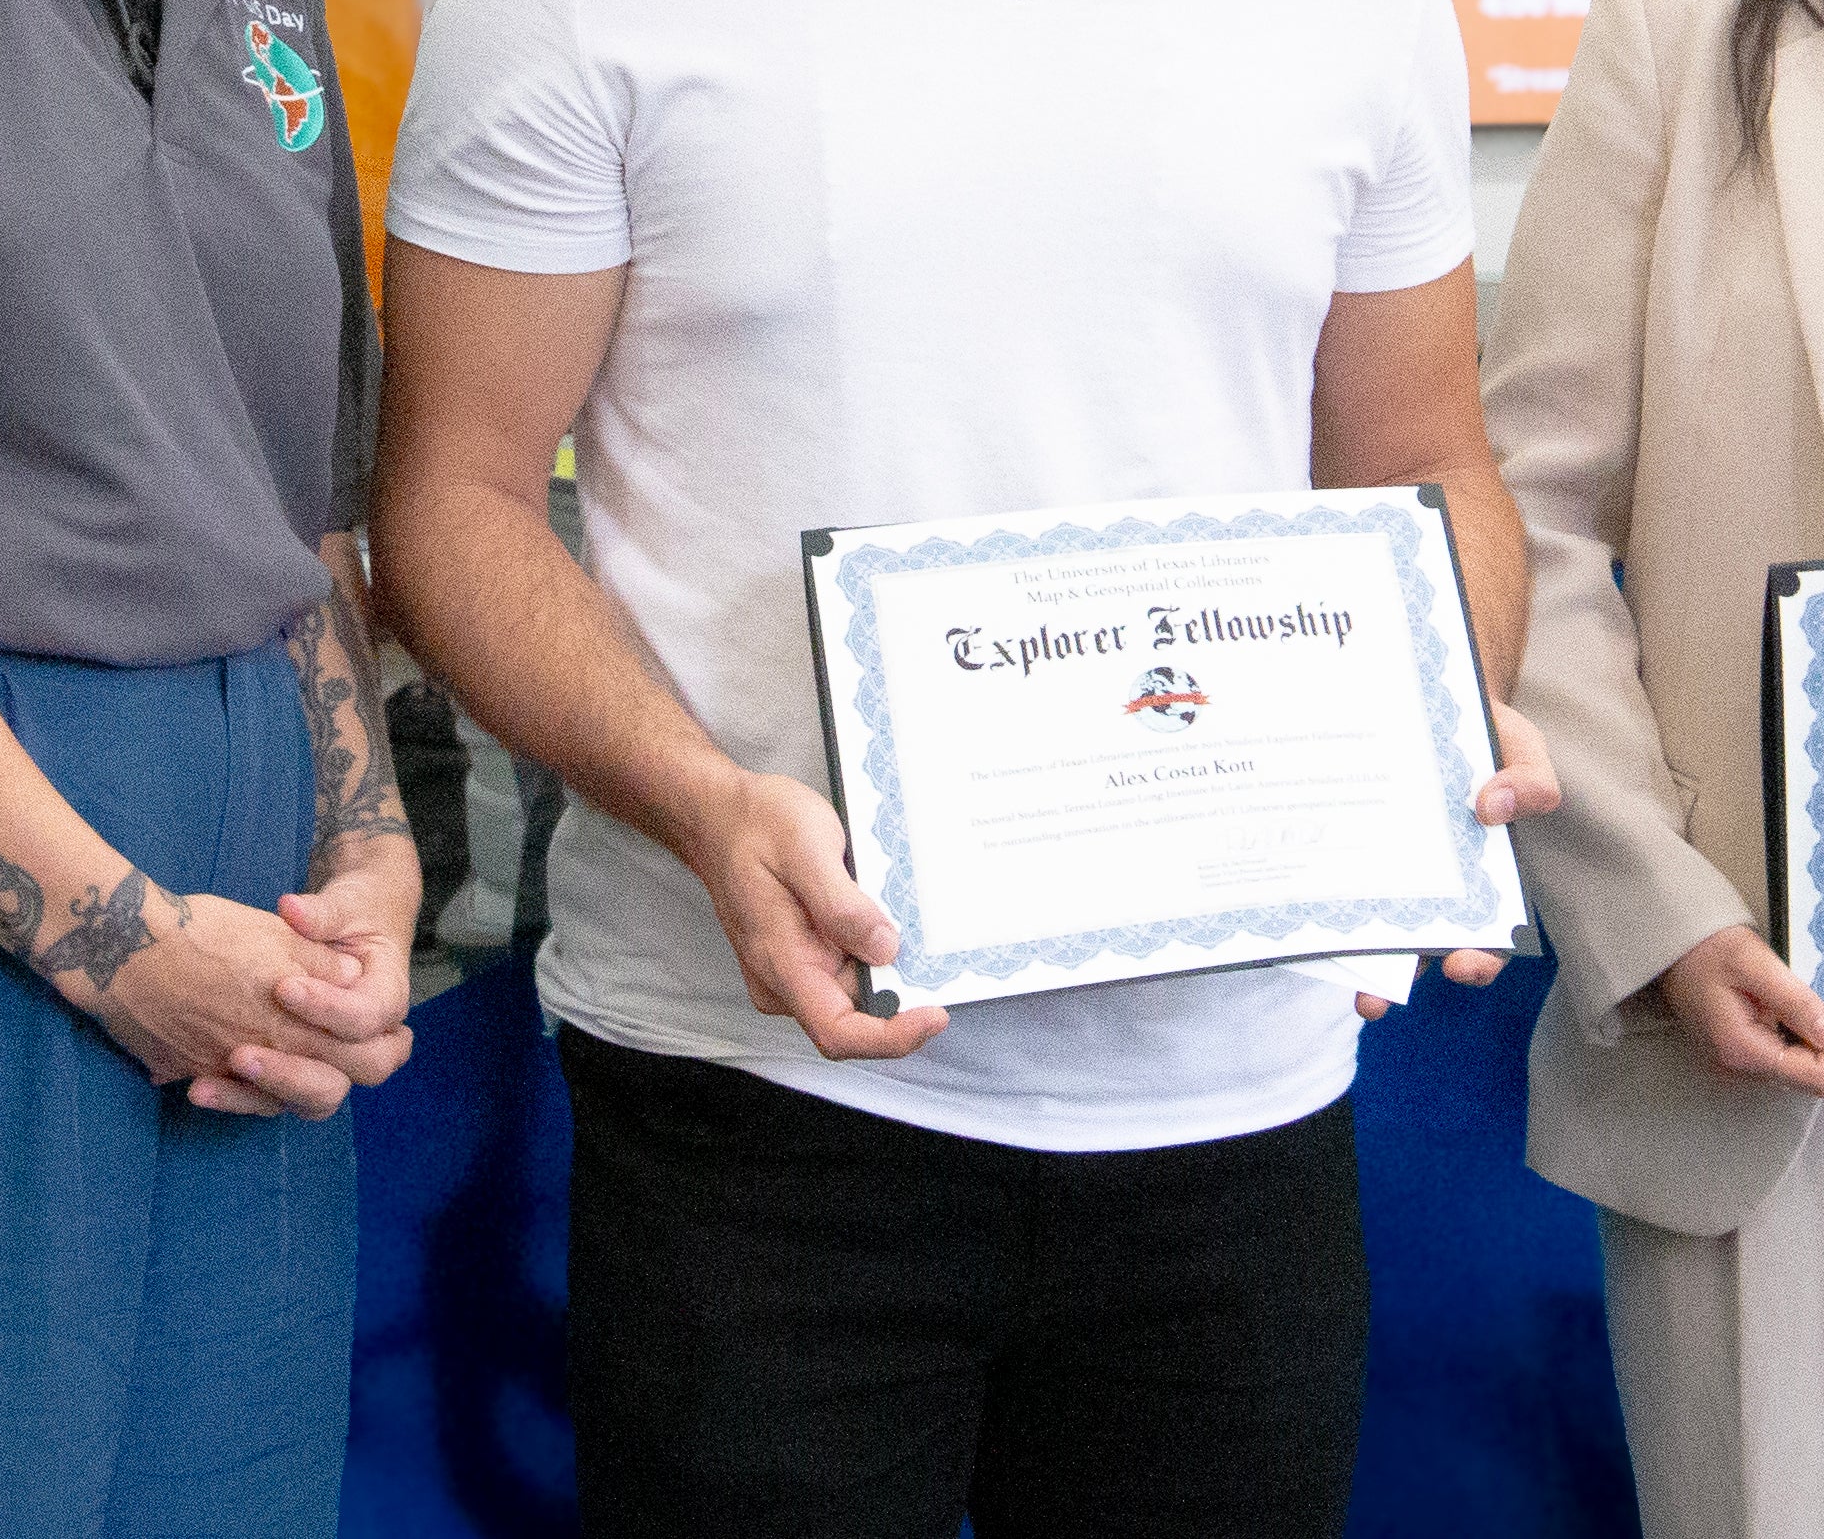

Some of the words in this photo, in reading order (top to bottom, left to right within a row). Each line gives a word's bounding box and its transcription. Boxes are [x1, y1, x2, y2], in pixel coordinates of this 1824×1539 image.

[265, 4, 305, 32] Day
[1012, 569, 1043, 585] The
[1048, 562, 1127, 581] University
[1132, 559, 1149, 573] of
[1154, 557, 1196, 572] Texas
[1200, 553, 1271, 568] Libraries
[1026, 589, 1064, 606] Map
[1067, 587, 1081, 600] &
[1084, 578, 1169, 599] Geospatial
[1173, 574, 1264, 591] Collections
[945, 624, 1128, 678] Explorer
[1146, 601, 1353, 651] Fellowship
[1104, 770, 1149, 789] Alex
[1153, 763, 1209, 781] Costa
[1213, 758, 1255, 774] Kott
